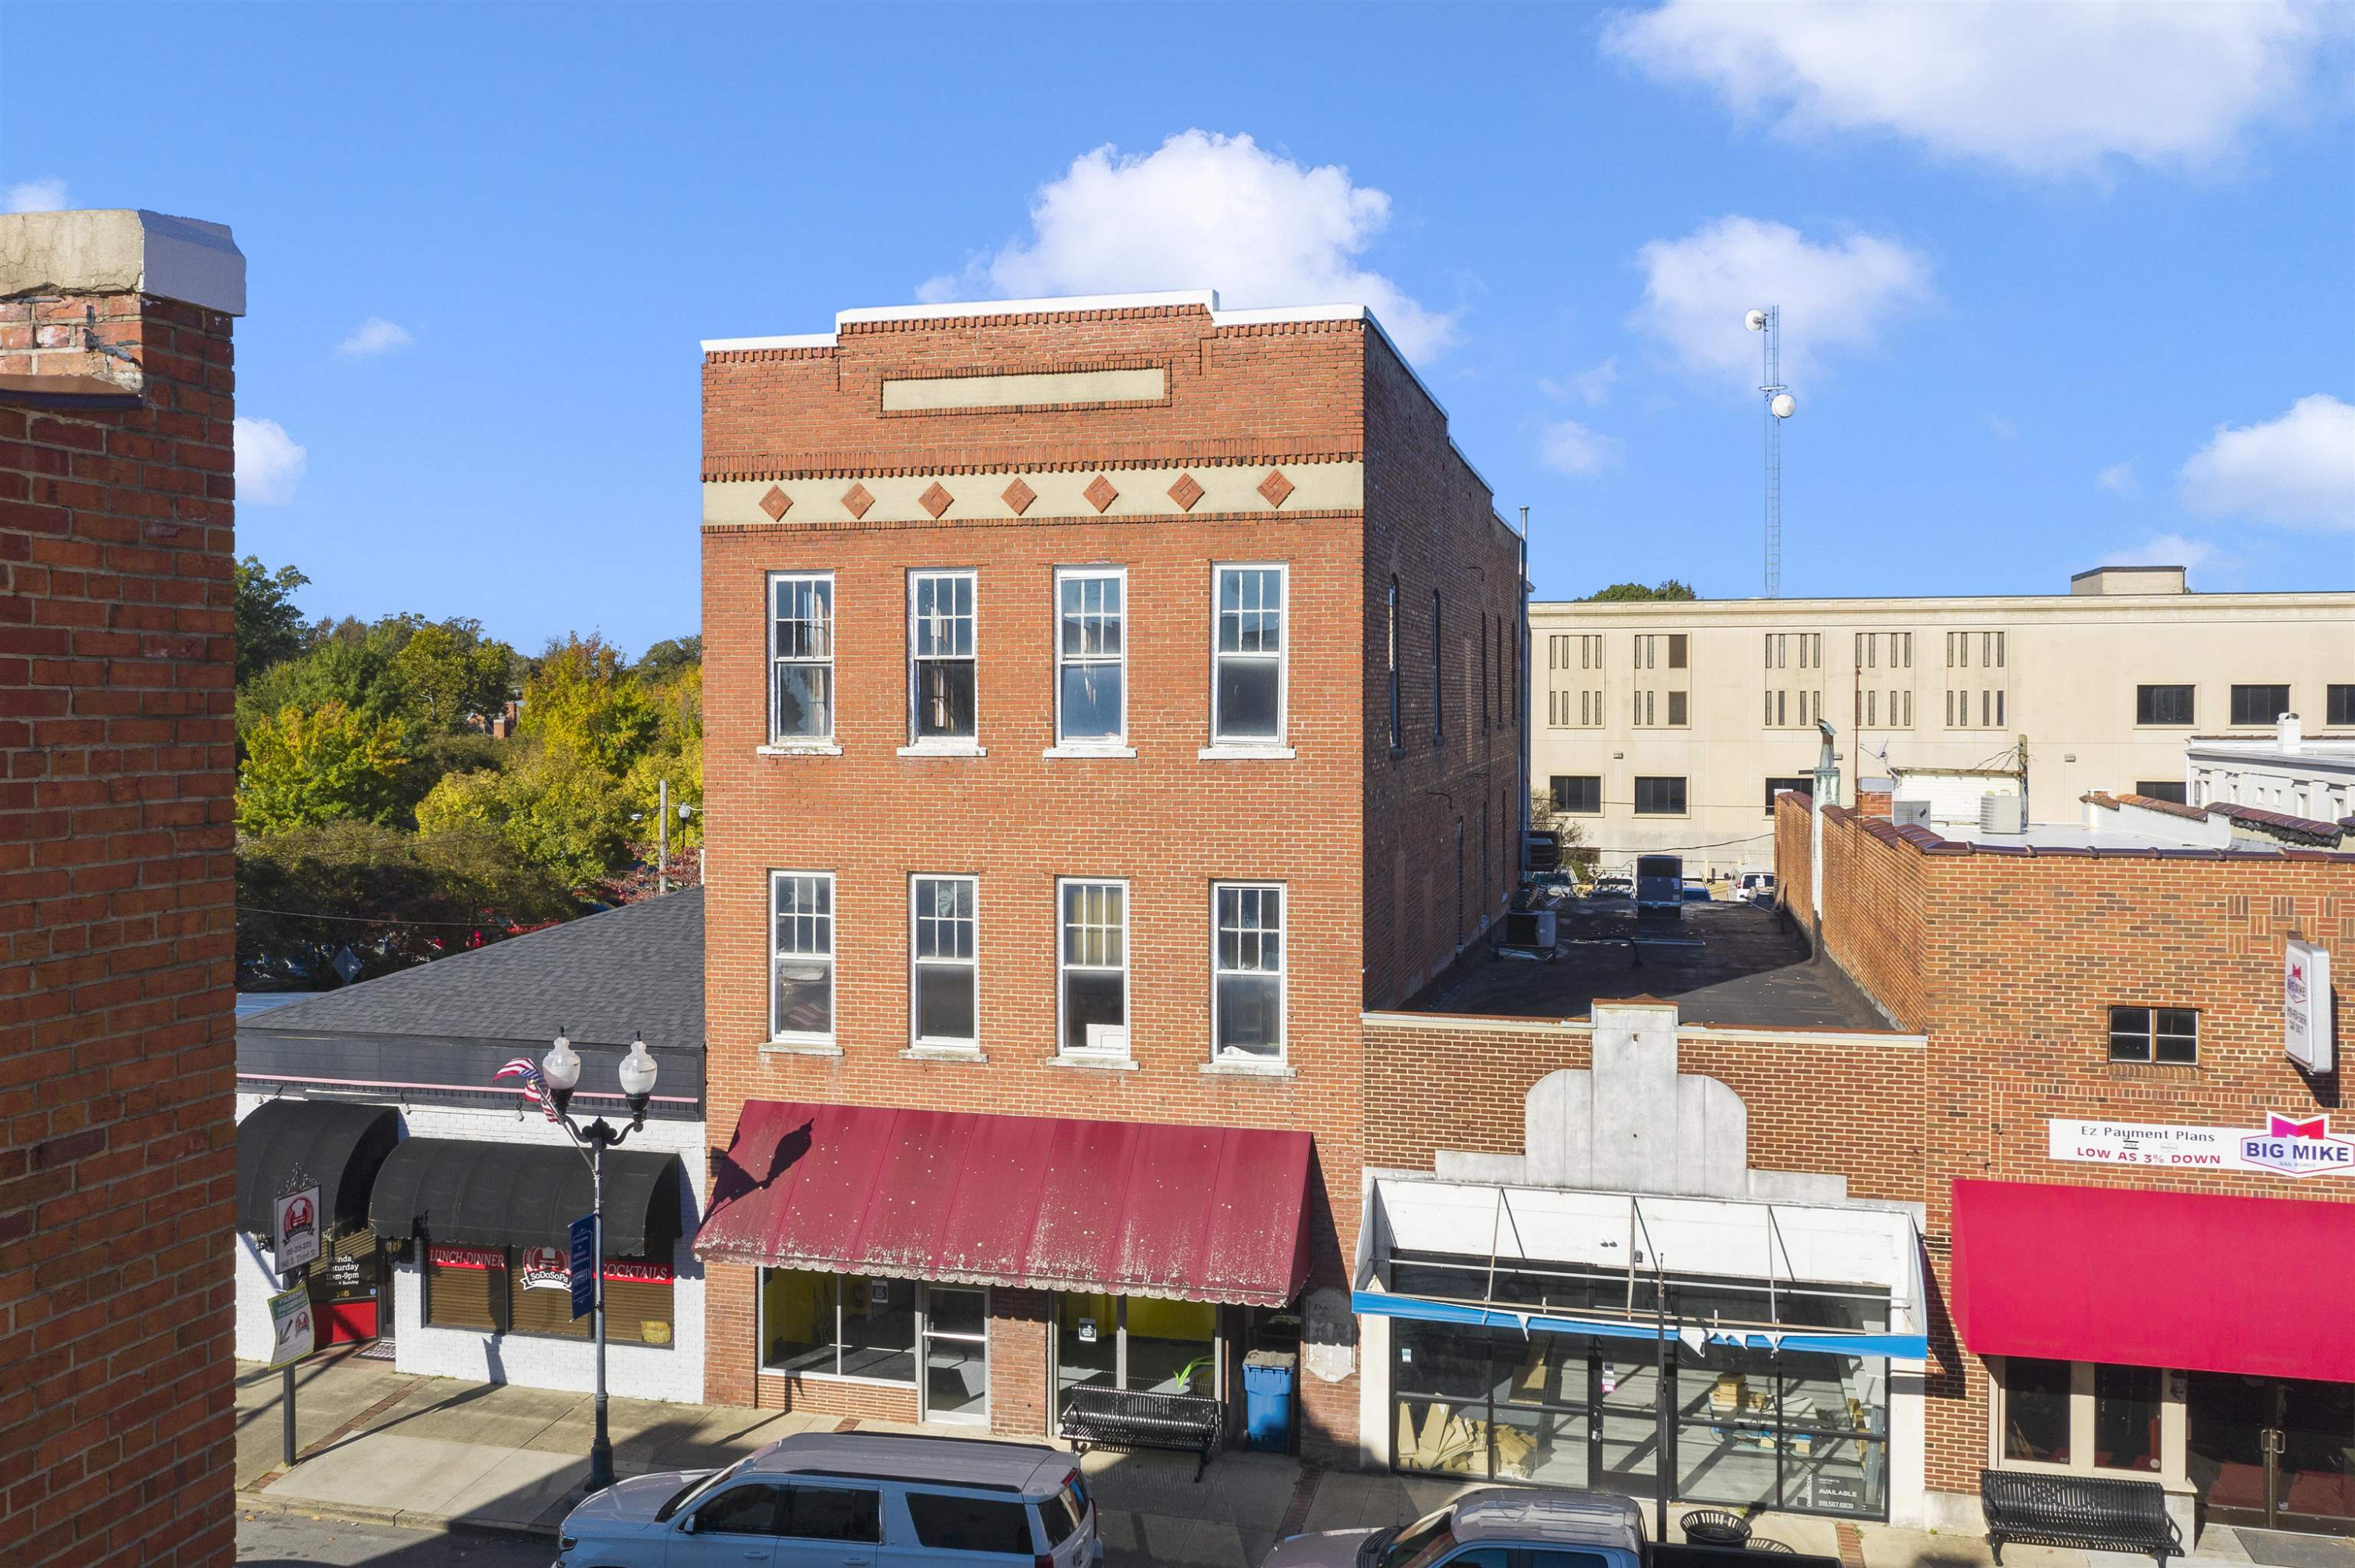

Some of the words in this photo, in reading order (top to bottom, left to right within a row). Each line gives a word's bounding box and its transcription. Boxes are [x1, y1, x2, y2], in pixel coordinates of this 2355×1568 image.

[2081, 1125, 2098, 1136] Ez
[2104, 1127, 2168, 1140] Payment
[2176, 1131, 2215, 1142] Plans
[2076, 1147, 2111, 1158] LOW
[2118, 1152, 2138, 1161] AS
[2144, 1154, 2164, 1164] 3%
[2171, 1154, 2221, 1164] DOWN
[2246, 1142, 2284, 1158] BIG
[2292, 1144, 2349, 1161] MIKE
[530, 1271, 569, 1283] SoDoSoPa
[1818, 1488, 1857, 1497] AVAILABLE
